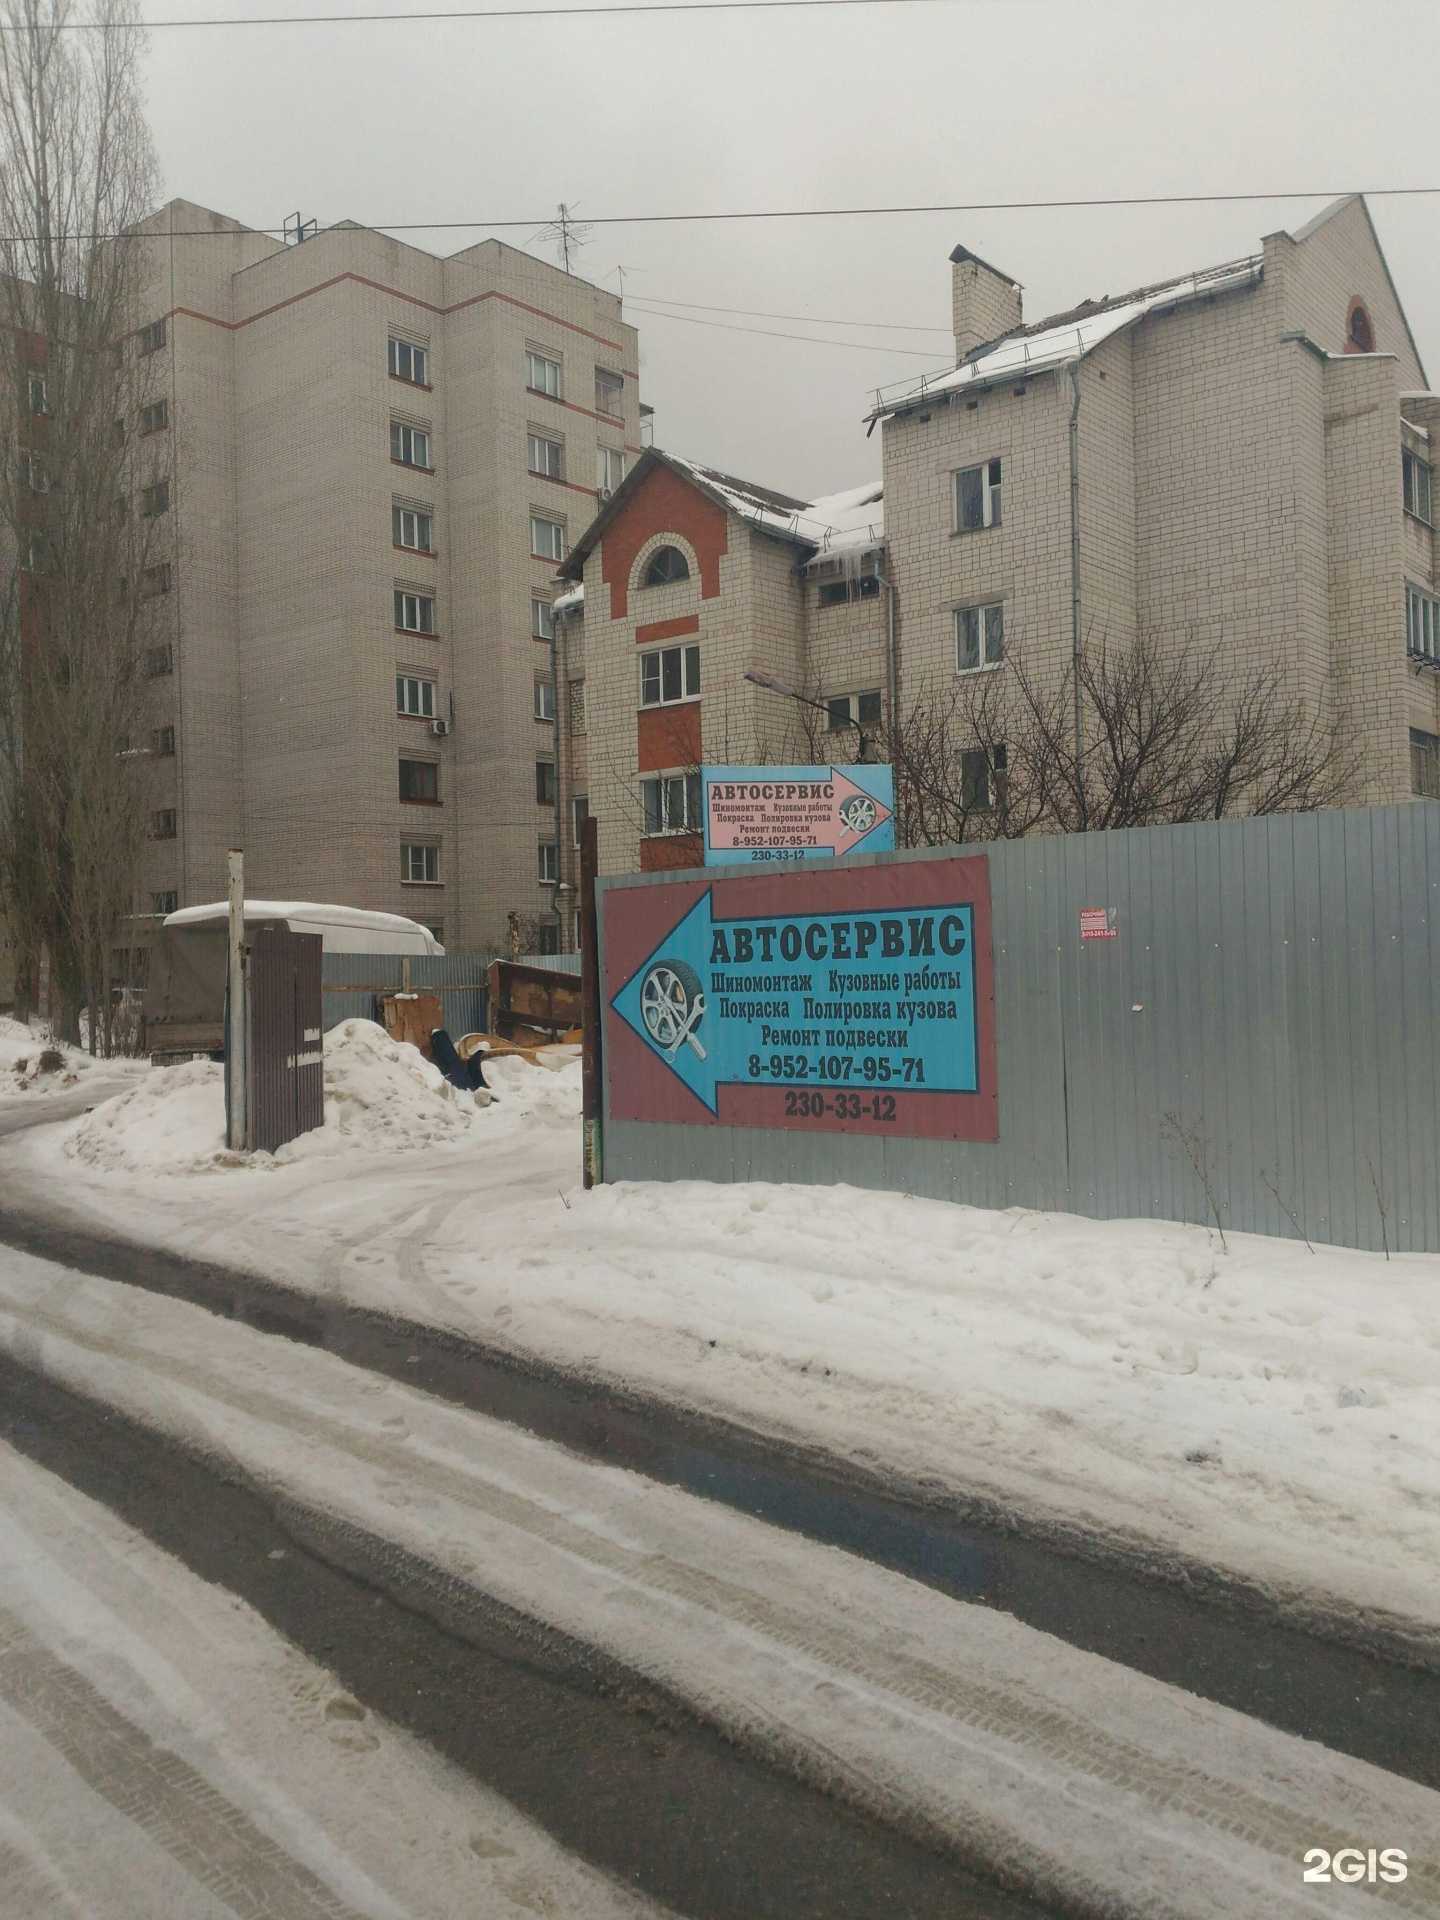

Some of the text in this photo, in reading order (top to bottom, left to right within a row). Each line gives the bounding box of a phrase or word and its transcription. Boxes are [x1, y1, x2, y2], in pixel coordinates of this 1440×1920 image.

[711, 784, 834, 800] АВТОСЕРВИС
[712, 803, 833, 813] Шиномонтаж Кузовные работы
[717, 814, 831, 823] Покраска Полировка кузова
[740, 825, 770, 833] Ремонт
[733, 836, 817, 846] 8-952-107-95-71
[752, 850, 804, 861] 230-33-12
[709, 915, 966, 964] АВТОСЕРВИС
[711, 964, 960, 998] Шиномонтаж Кузовные работы
[720, 998, 957, 1025] Покраска Полировка кузова
[762, 1025, 908, 1050] Ремонт подвески
[749, 1055, 925, 1083] 8-952-107-95-71
[785, 1091, 896, 1121] 230-33-12
